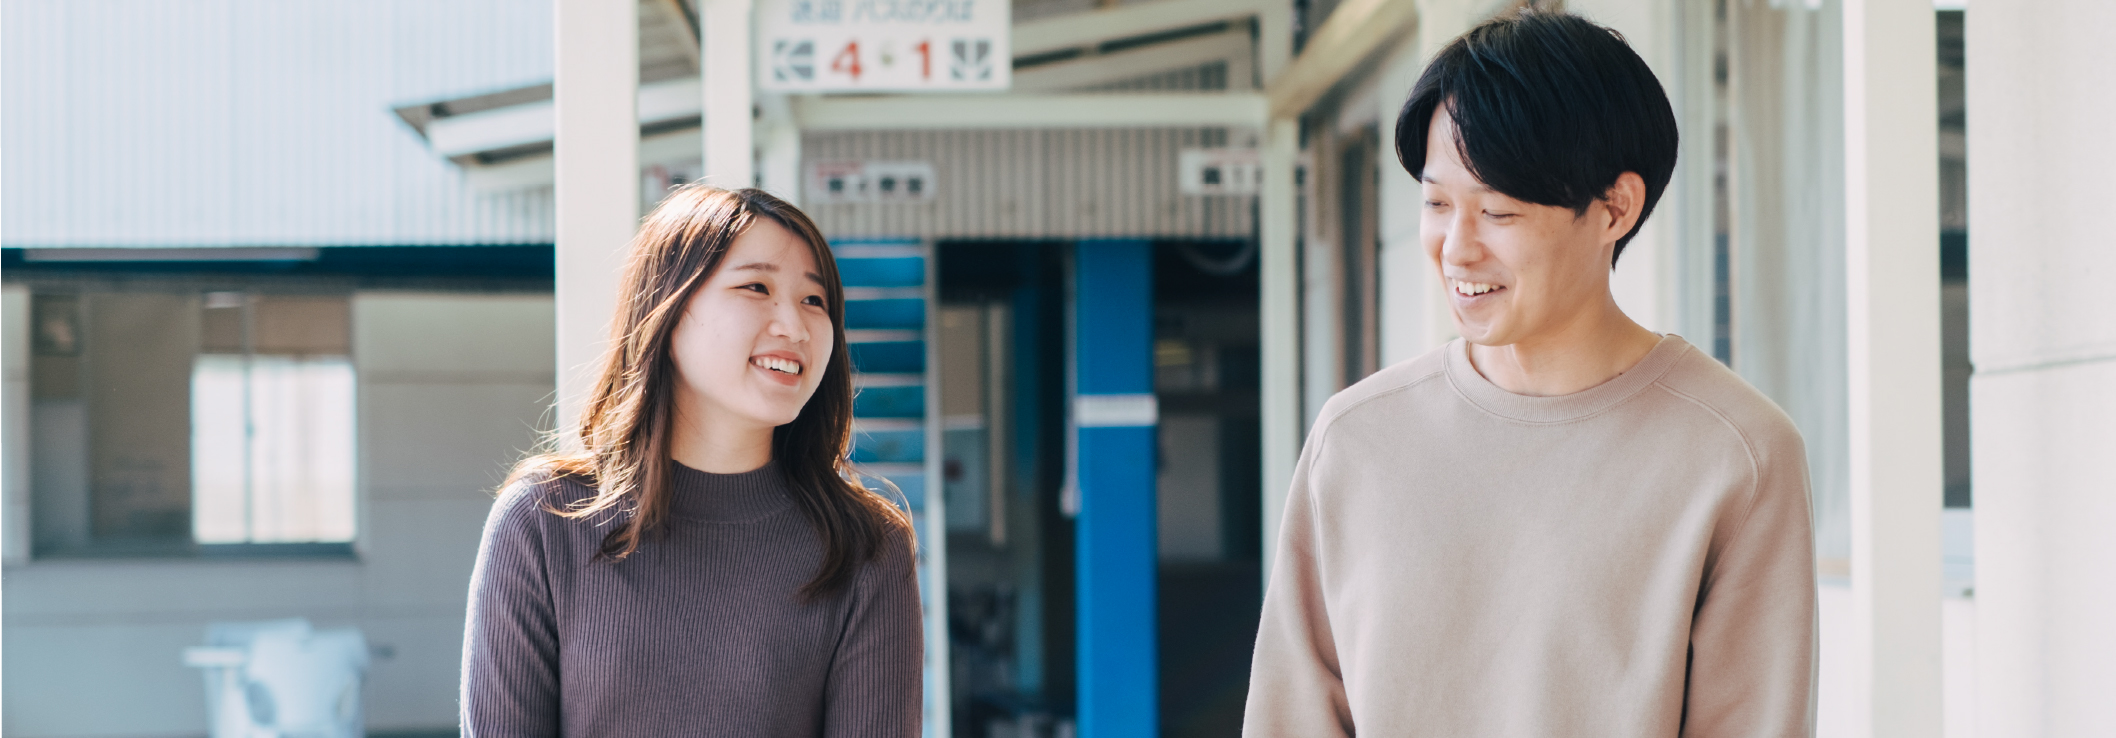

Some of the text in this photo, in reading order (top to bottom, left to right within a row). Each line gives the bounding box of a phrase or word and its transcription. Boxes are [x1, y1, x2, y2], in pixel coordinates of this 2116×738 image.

[853, 0, 974, 21] バスのりば
[831, 41, 931, 78] 4 1
